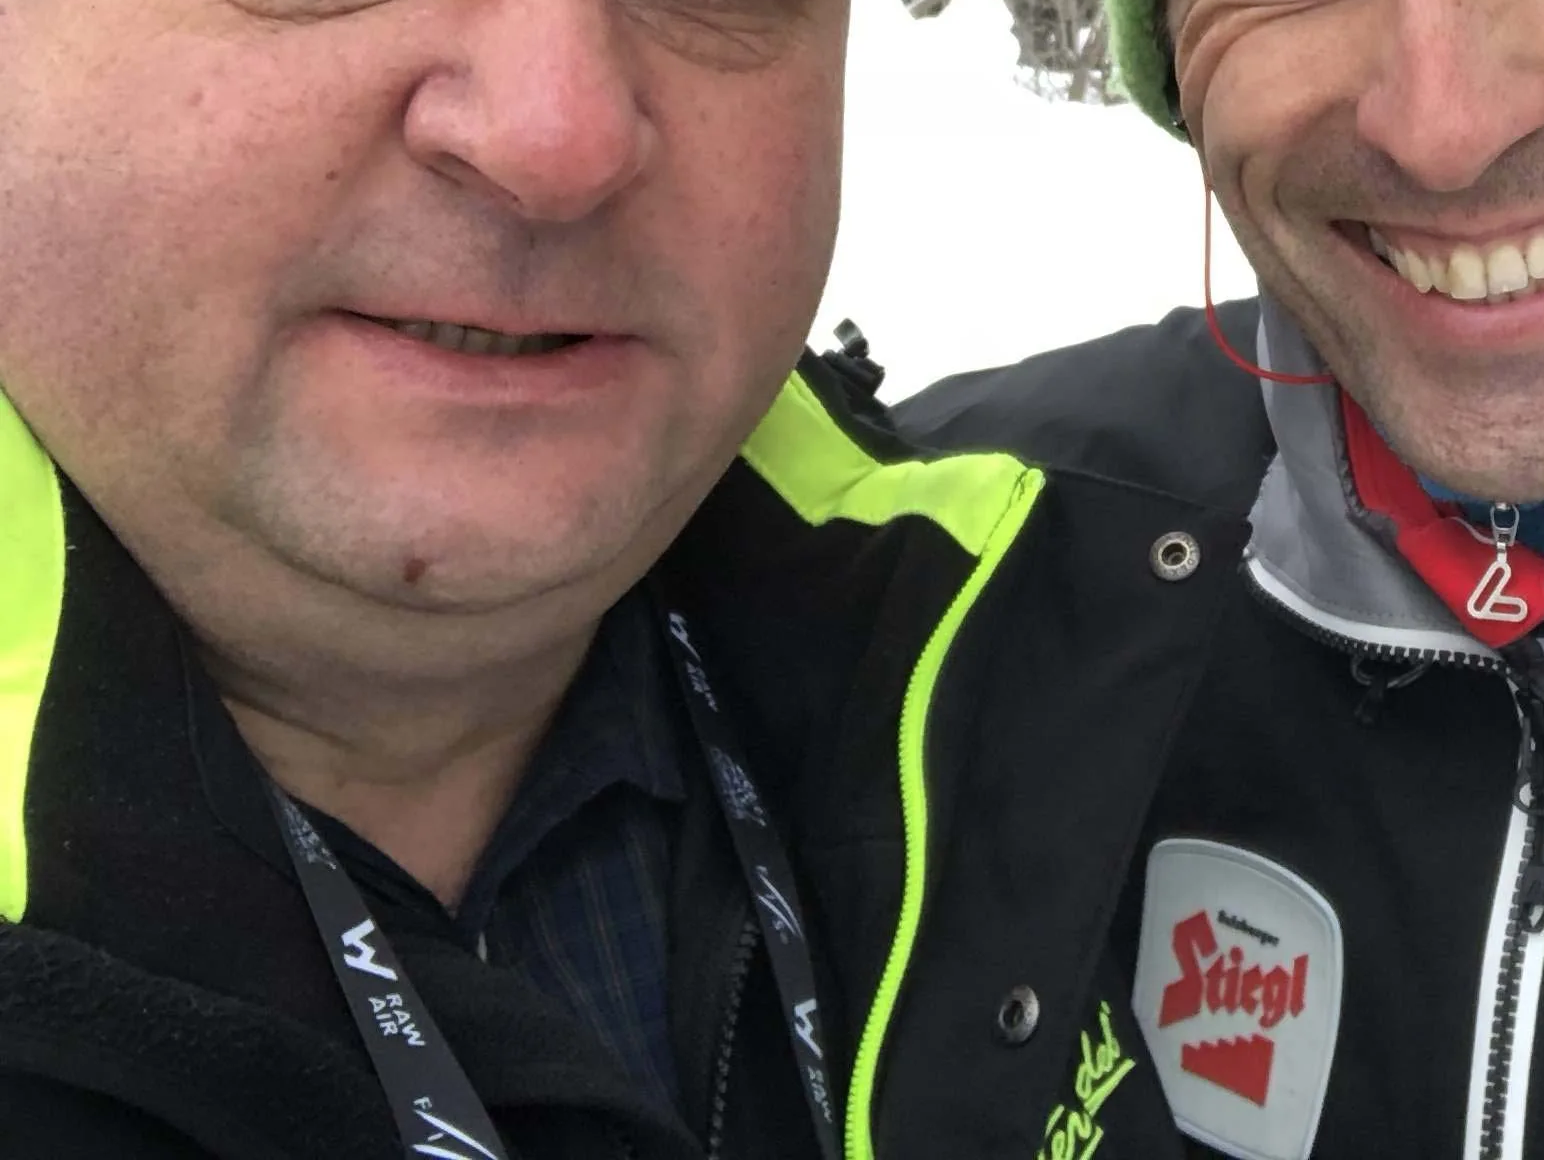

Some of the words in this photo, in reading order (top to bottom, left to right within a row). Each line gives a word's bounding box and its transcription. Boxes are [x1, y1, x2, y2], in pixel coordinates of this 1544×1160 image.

[1158, 909, 1309, 1029] Stiegl
[367, 996, 399, 1037] AIR
[386, 992, 427, 1046] RAW
